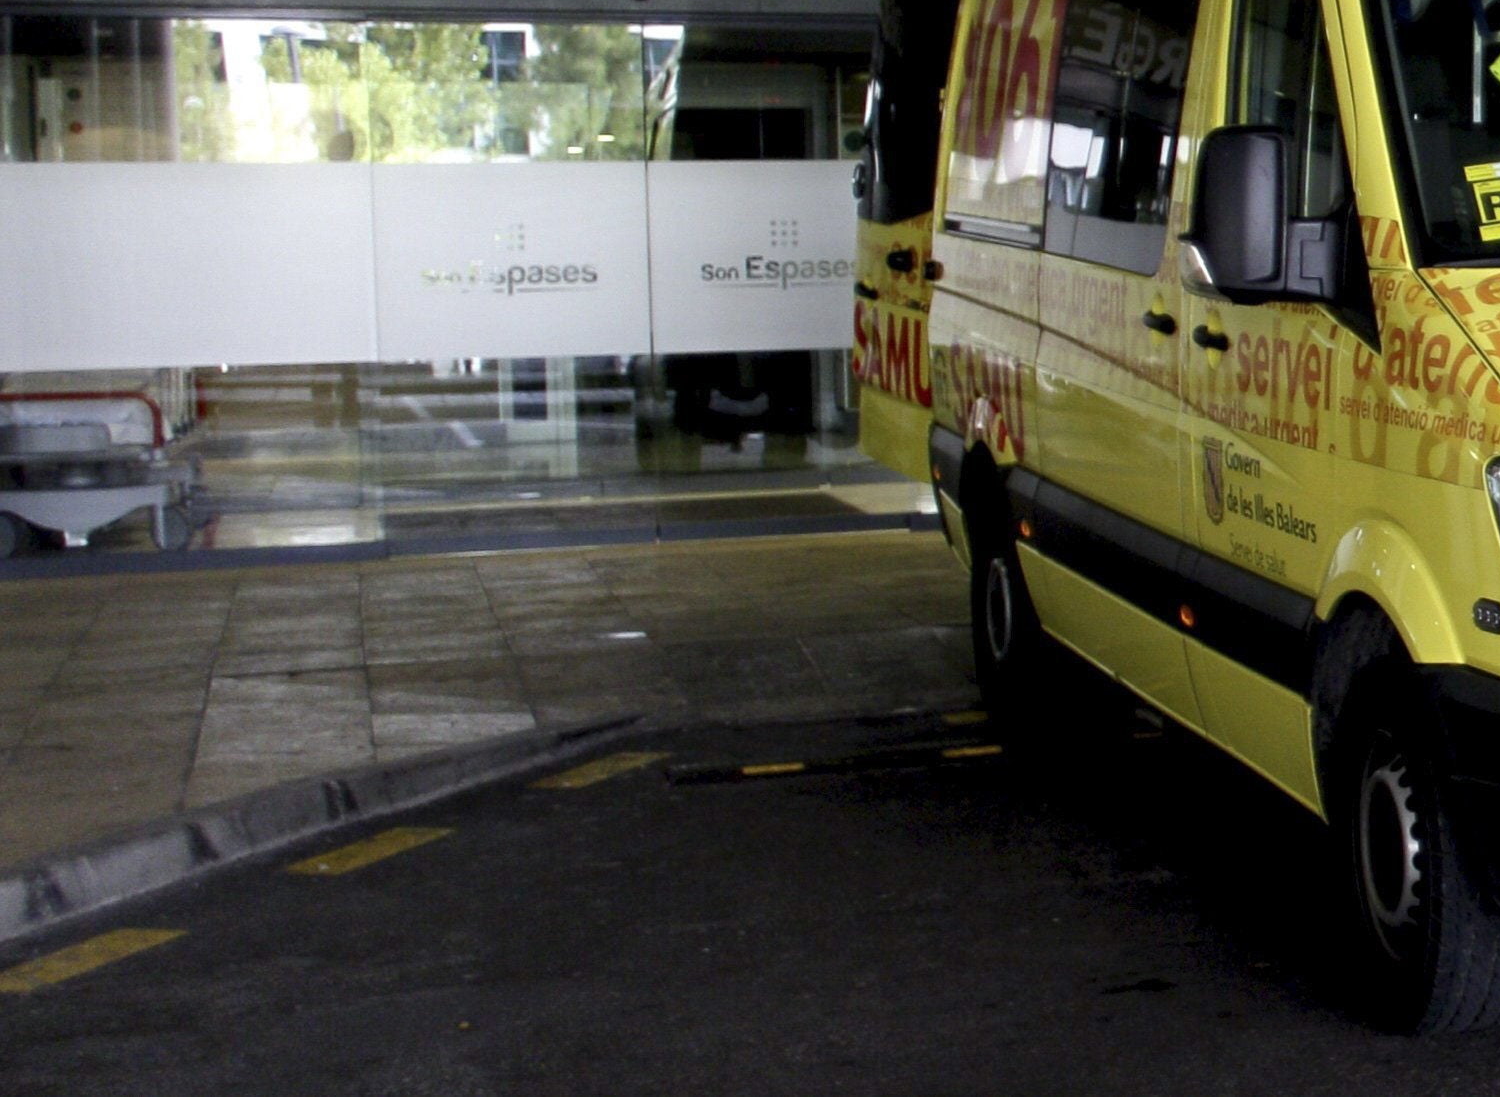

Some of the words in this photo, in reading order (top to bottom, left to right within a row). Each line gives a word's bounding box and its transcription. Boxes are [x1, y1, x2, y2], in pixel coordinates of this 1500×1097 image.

[701, 263, 740, 282] Son
[1236, 323, 1336, 411] servei
[1225, 441, 1262, 480] Govern
[1227, 488, 1239, 514] de
[1239, 491, 1254, 520] les
[1275, 502, 1318, 544] Balears
